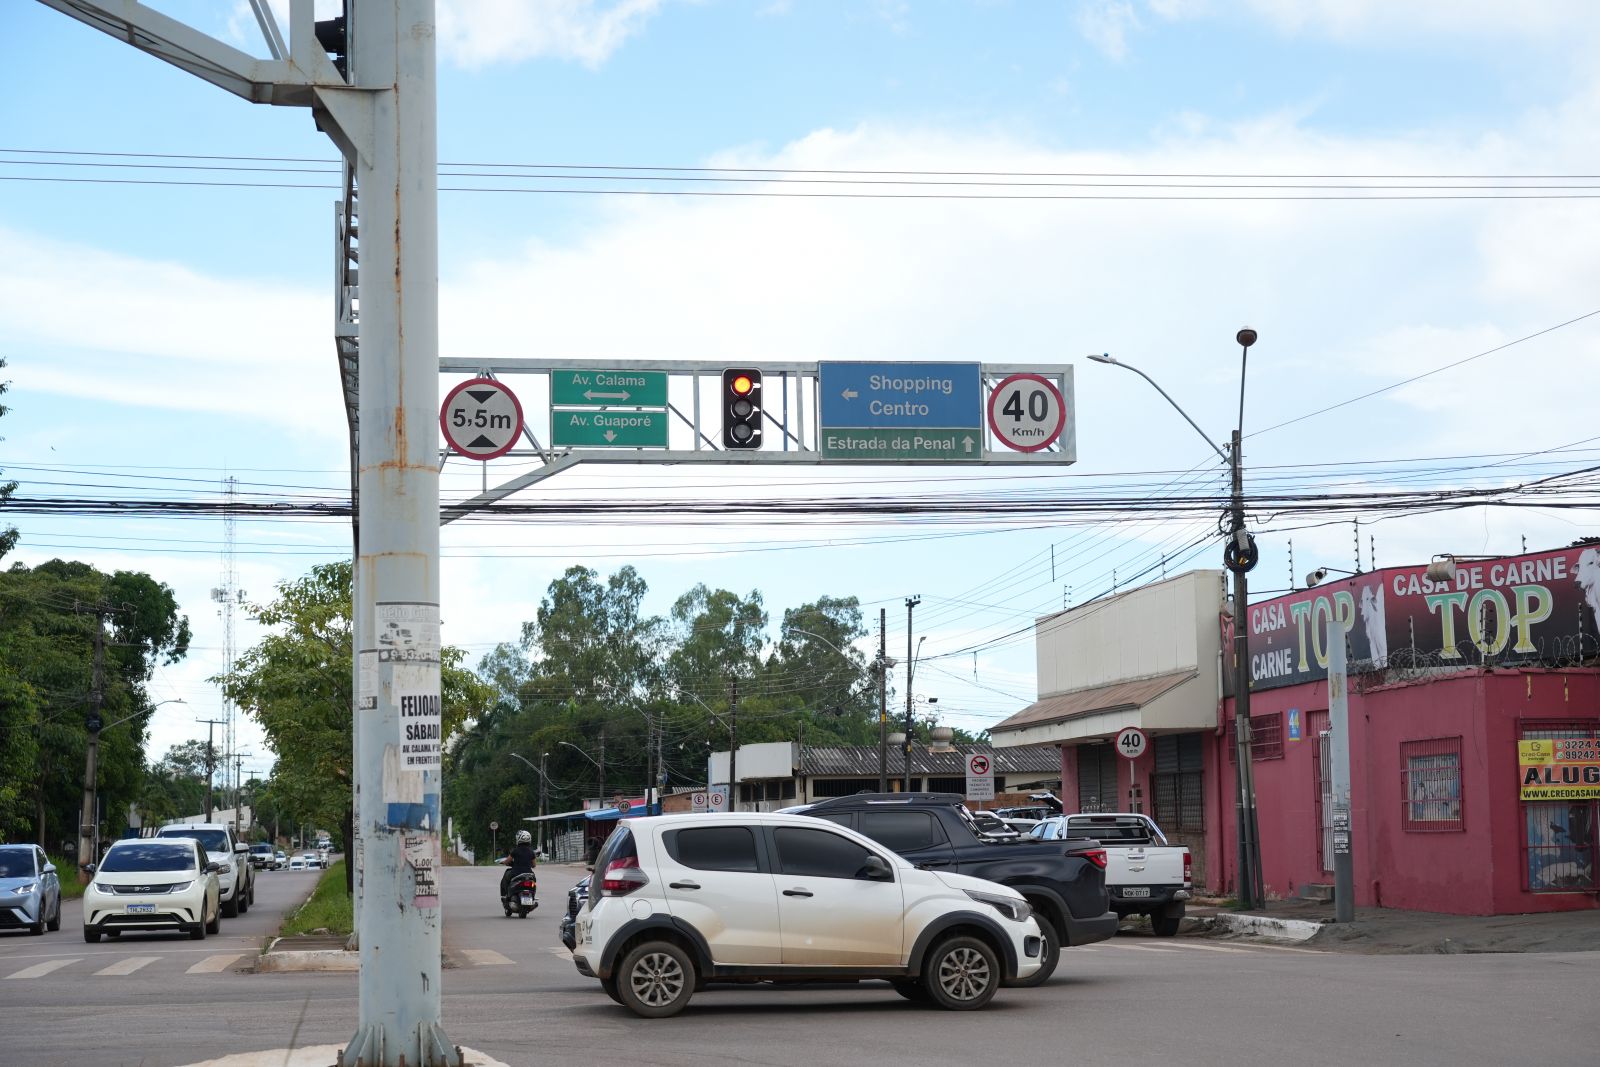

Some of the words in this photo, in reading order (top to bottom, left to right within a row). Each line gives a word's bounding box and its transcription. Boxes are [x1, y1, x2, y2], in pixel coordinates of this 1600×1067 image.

[572, 373, 592, 385] Av.
[596, 374, 646, 386] Calama
[869, 375, 953, 394] Shopping
[869, 400, 929, 416] Centro
[1002, 389, 1049, 422] 40
[452, 408, 511, 429] 5,5m
[570, 414, 590, 426] Av.
[593, 414, 652, 429] Guaporé
[1012, 427, 1045, 437] Km/h
[827, 436, 887, 450] Estrada
[891, 437, 911, 450] da
[913, 437, 956, 450] Penal
[1455, 566, 1484, 591] DE
[1490, 556, 1568, 587] CARNE
[1252, 602, 1287, 635] CASA
[1424, 585, 1553, 659] TOP
[1251, 647, 1293, 681] CARNE
[1121, 733, 1141, 748] 40
[1565, 740, 1591, 749] 3224
[1565, 750, 1595, 759] 99242
